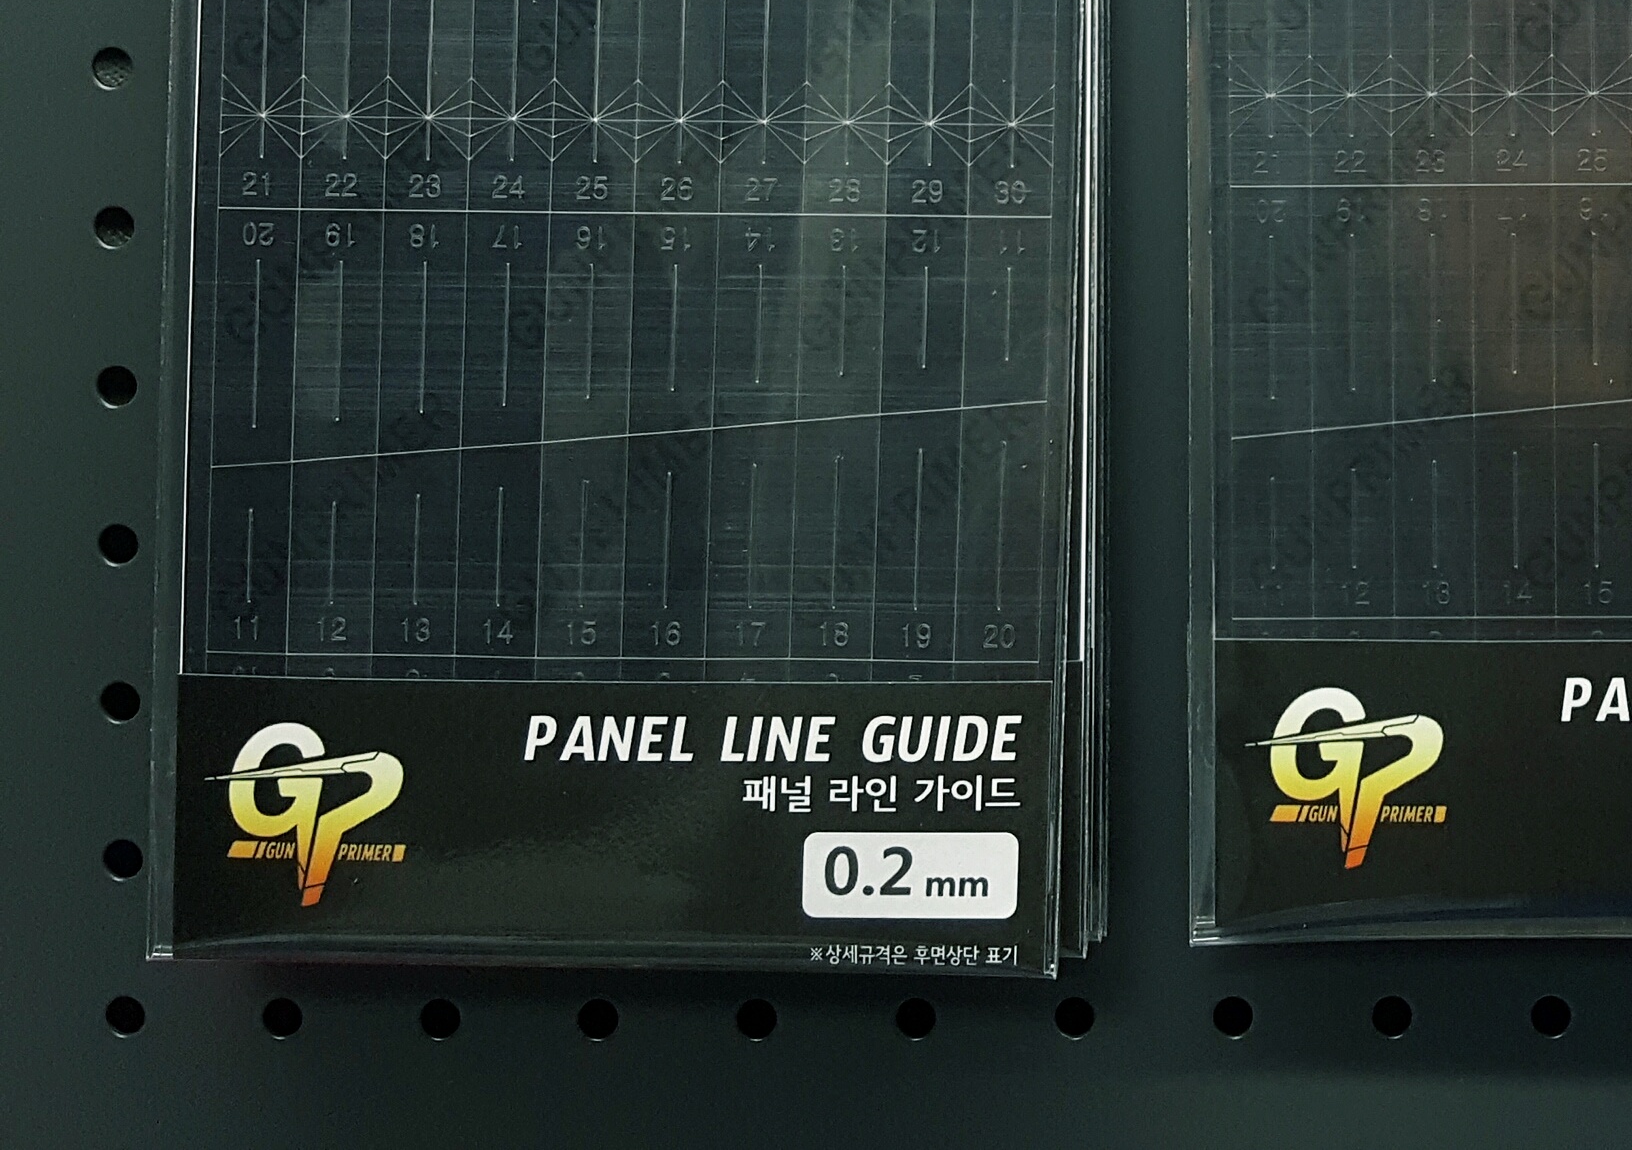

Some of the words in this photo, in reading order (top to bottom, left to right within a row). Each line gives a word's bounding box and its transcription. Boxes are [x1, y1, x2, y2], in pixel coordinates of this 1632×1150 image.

[325, 173, 357, 197] 22
[409, 174, 440, 197] 23
[493, 175, 525, 198] 24
[576, 176, 607, 199] 25
[661, 177, 692, 200] 26
[912, 180, 942, 203] 29
[234, 616, 258, 640] 11
[318, 617, 346, 641] 12
[402, 618, 429, 642] 13
[484, 619, 513, 644] 14
[568, 621, 595, 644] 15
[652, 622, 680, 645] 16
[737, 622, 765, 646] 17
[820, 622, 848, 646] 18
[903, 623, 930, 648] 19
[983, 624, 1014, 648] 20
[524, 715, 694, 762] PANEL
[721, 716, 836, 763] LINE
[862, 715, 1022, 763] GUIDE
[743, 776, 811, 813] 패널
[829, 776, 897, 812] 라인
[914, 776, 1021, 812] 가이드
[1309, 806, 1338, 822] GUN
[1380, 806, 1434, 822] PRIMER
[266, 842, 295, 859] GUN
[338, 844, 392, 861] PRIMER
[825, 846, 913, 895] 0.2
[926, 877, 988, 897] mm
[913, 945, 980, 966] 후면상단
[985, 946, 1018, 966] 표기
